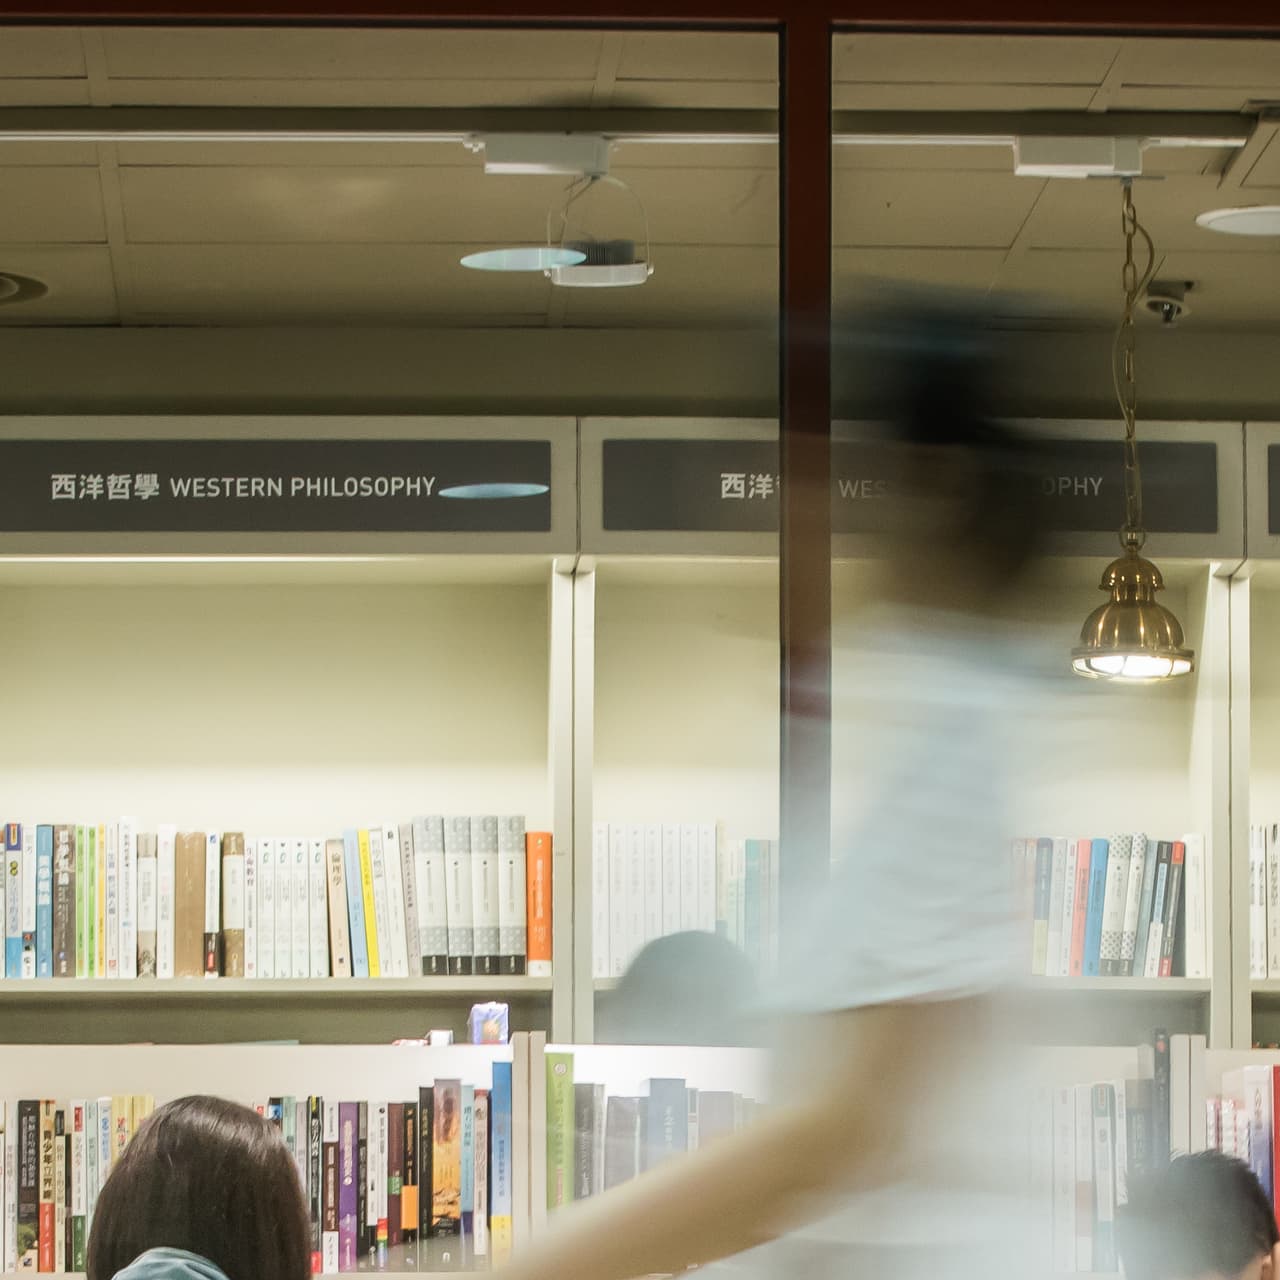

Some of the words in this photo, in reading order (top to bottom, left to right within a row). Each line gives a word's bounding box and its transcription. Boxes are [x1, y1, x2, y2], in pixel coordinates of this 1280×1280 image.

[50, 472, 160, 501] 西洋哲學
[169, 477, 283, 498] WESTERN
[290, 475, 436, 497] PHILOSOPHY
[719, 472, 781, 501] 西洋
